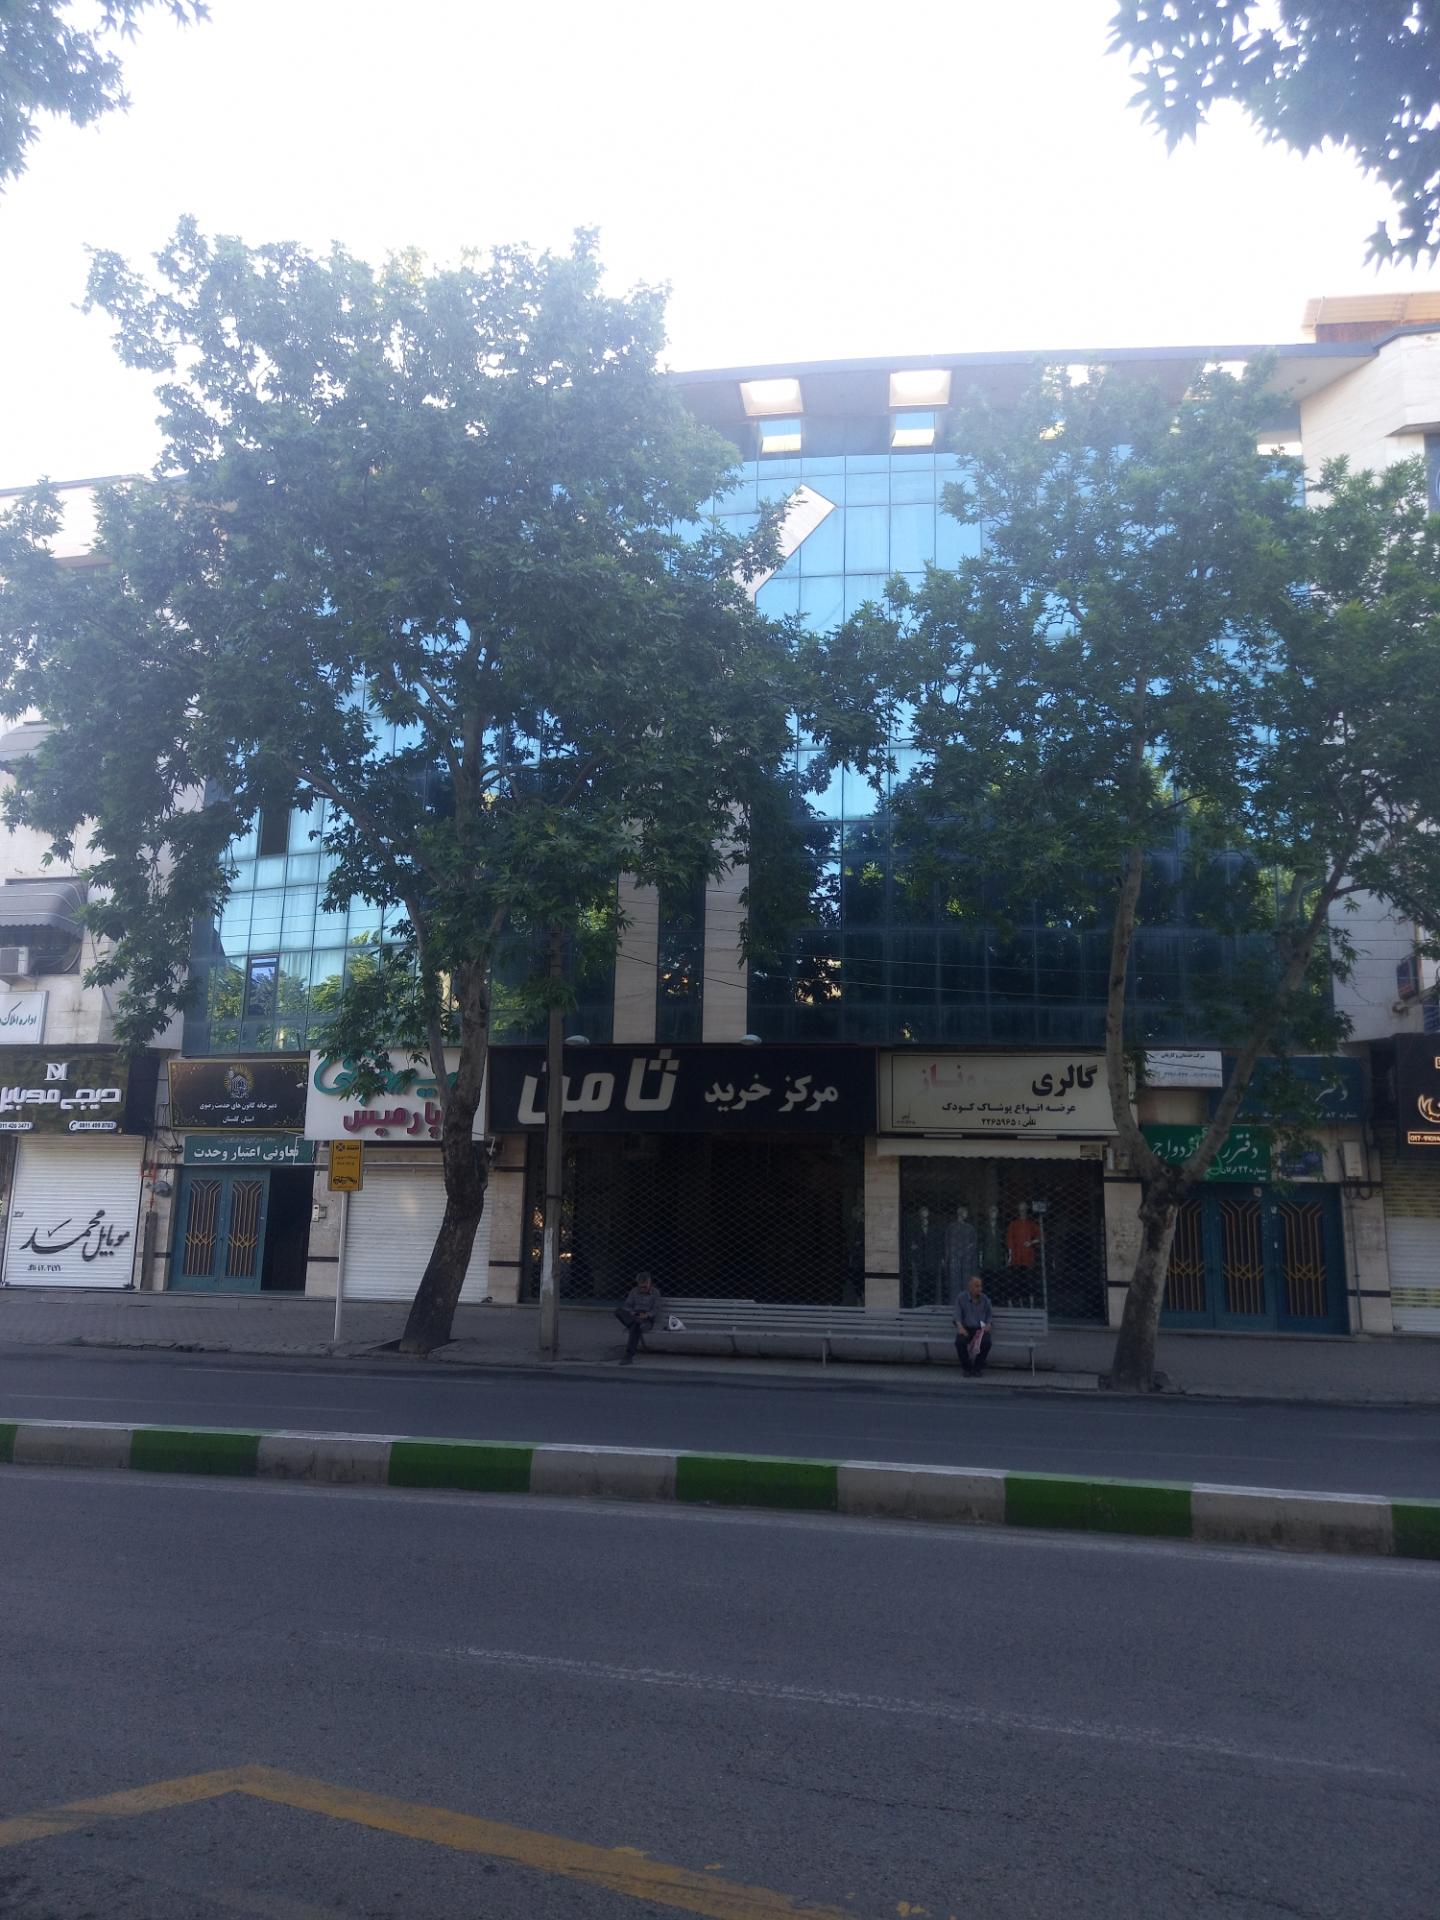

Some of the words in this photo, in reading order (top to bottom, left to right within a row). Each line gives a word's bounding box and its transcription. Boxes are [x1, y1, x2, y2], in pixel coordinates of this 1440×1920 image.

[516, 1047, 681, 1125] ثامن
[1031, 1063, 1098, 1097] گالری
[704, 1072, 772, 1112] خرید
[777, 1074, 840, 1112] مرکز
[942, 1102, 976, 1114] کودک
[977, 1102, 1013, 1115] پوشاک
[1014, 1103, 1044, 1115] انواع
[1046, 1103, 1077, 1114] عرضه
[193, 1147, 228, 1161] وحدت
[230, 1145, 260, 1161] اعتبار
[1226, 1133, 1259, 1164] دفتر
[82, 1224, 130, 1262] موبایل
